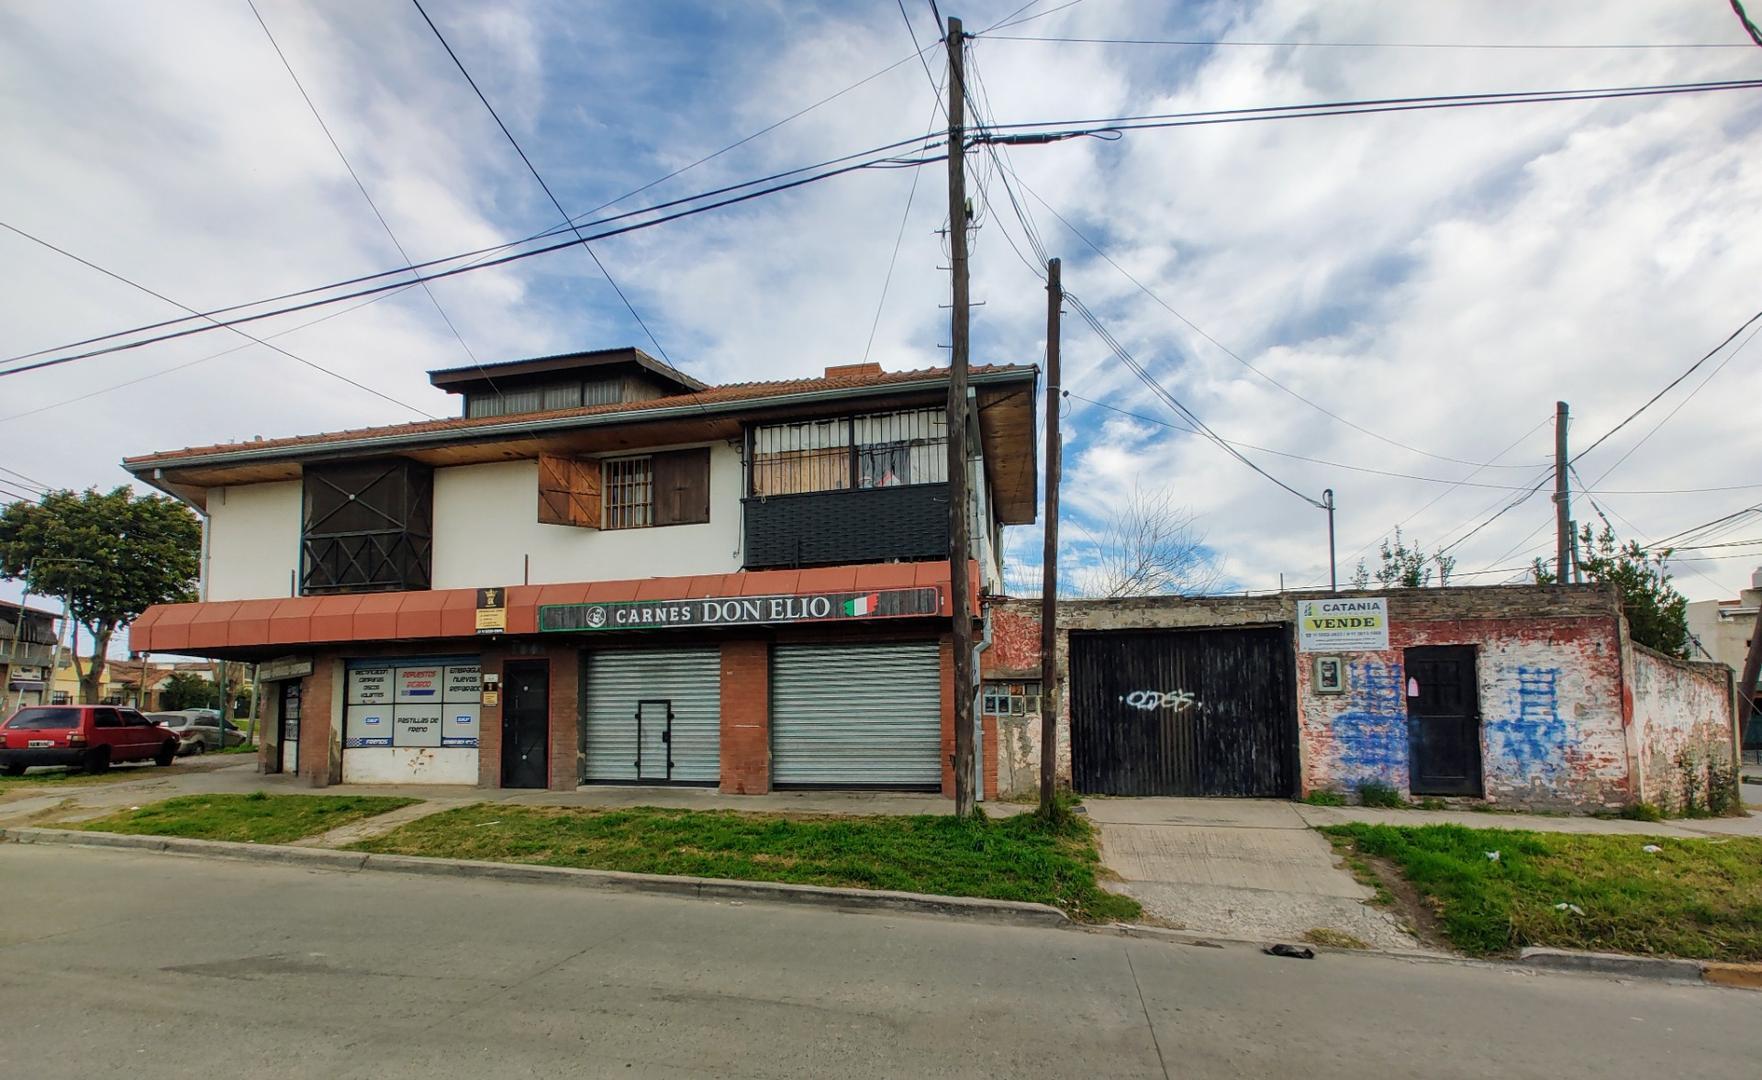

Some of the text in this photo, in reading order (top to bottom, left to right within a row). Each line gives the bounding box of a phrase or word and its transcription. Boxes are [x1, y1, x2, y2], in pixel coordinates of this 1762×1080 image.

[616, 597, 831, 623] CARNES DON ELIO
[1322, 602, 1380, 612] CATANIA
[1313, 617, 1375, 629] VENDE
